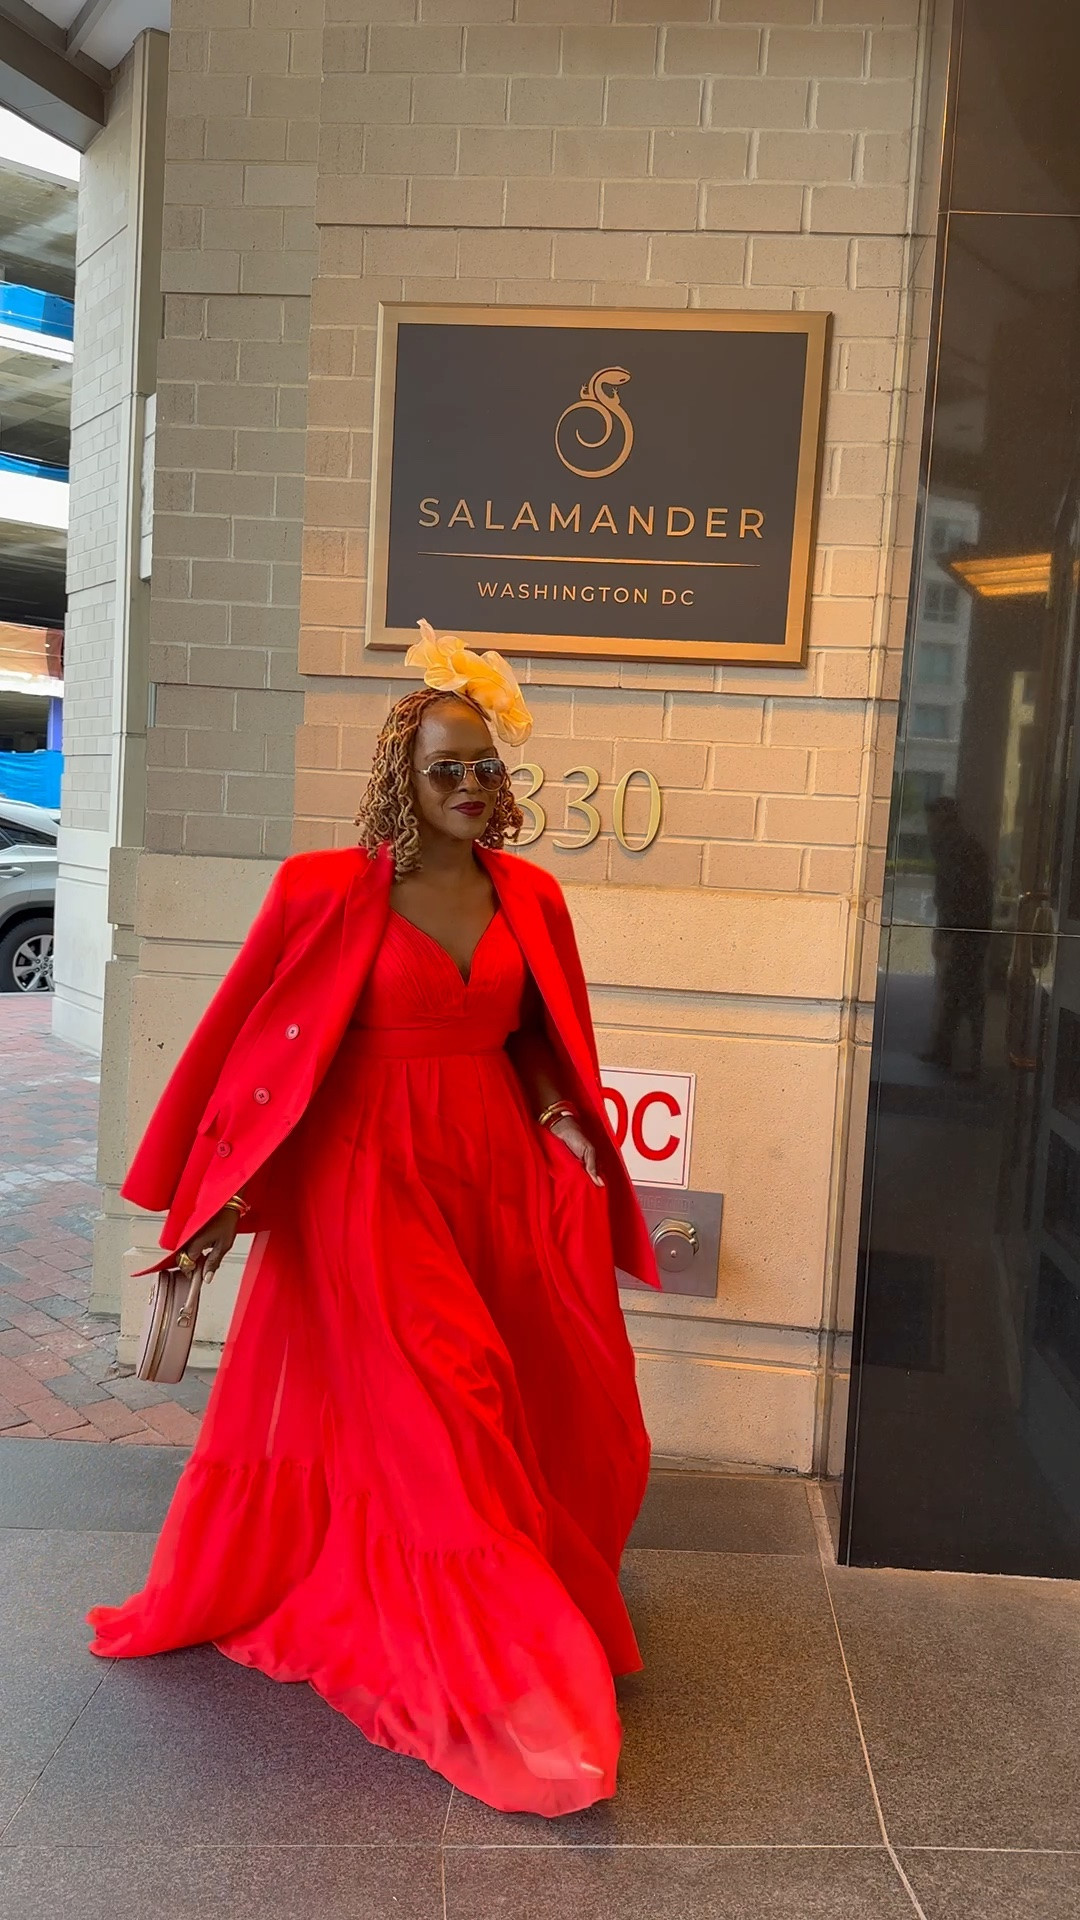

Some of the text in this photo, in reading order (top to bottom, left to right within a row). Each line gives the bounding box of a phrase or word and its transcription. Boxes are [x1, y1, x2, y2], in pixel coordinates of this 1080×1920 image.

[418, 497, 765, 539] SALAMANDER
[477, 582, 695, 606] WASHINGTON DC
